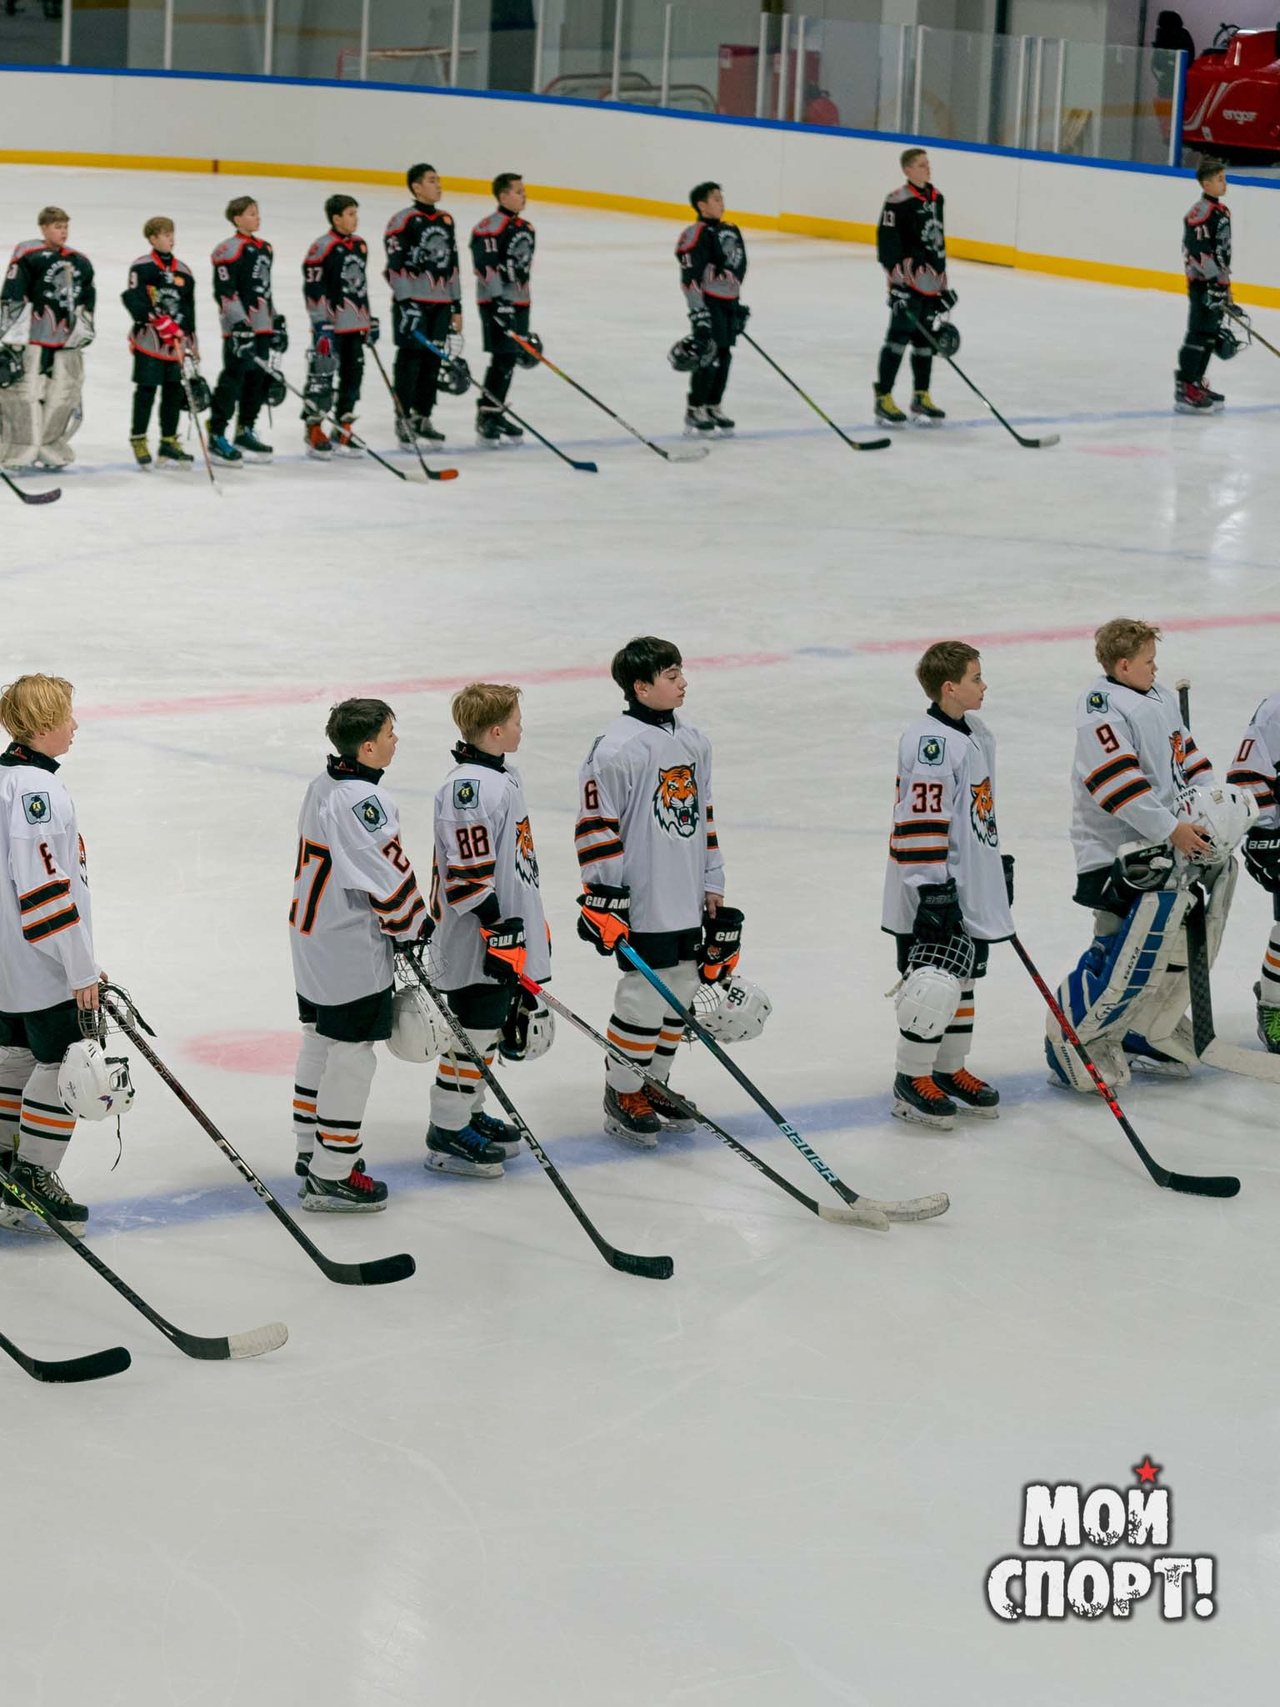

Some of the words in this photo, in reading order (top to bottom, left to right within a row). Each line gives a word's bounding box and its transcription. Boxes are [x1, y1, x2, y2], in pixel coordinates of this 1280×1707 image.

[306, 267, 324, 283] 37
[1095, 723, 1121, 754] 9
[911, 781, 944, 814] 33
[381, 834, 411, 875] 2
[455, 824, 491, 861] 88
[489, 934, 514, 947] СШ
[715, 930, 740, 943] СШ
[507, 1111, 552, 1170] CCM
[777, 1119, 839, 1185] BAUER
[212, 1137, 275, 1204] CCM
